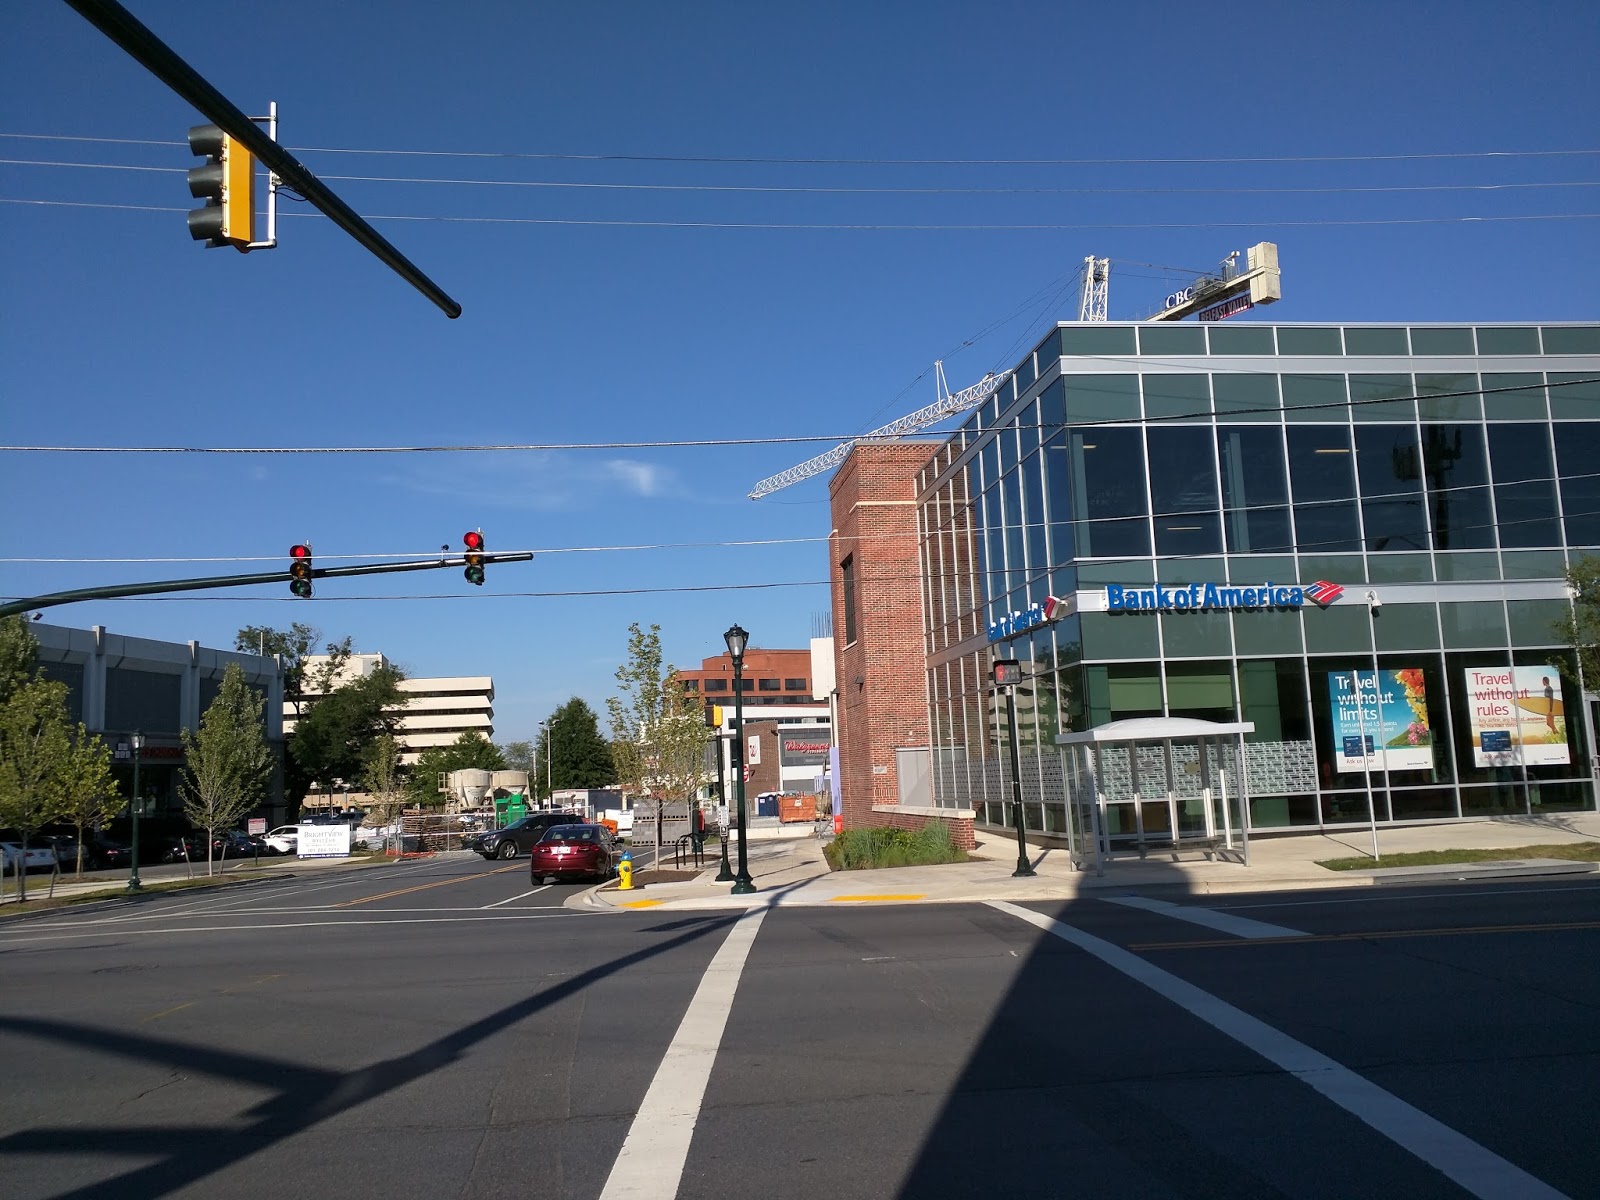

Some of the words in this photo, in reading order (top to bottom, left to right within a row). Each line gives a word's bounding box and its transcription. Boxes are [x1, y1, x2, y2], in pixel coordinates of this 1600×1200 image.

[1166, 286, 1193, 309] CBC
[1105, 583, 1171, 610] Bank
[1173, 583, 1200, 609] of
[1201, 581, 1303, 608] America
[1335, 675, 1377, 690] Trvel
[1472, 671, 1512, 686] Travel
[1475, 688, 1530, 701] without
[1477, 702, 1510, 716] rules
